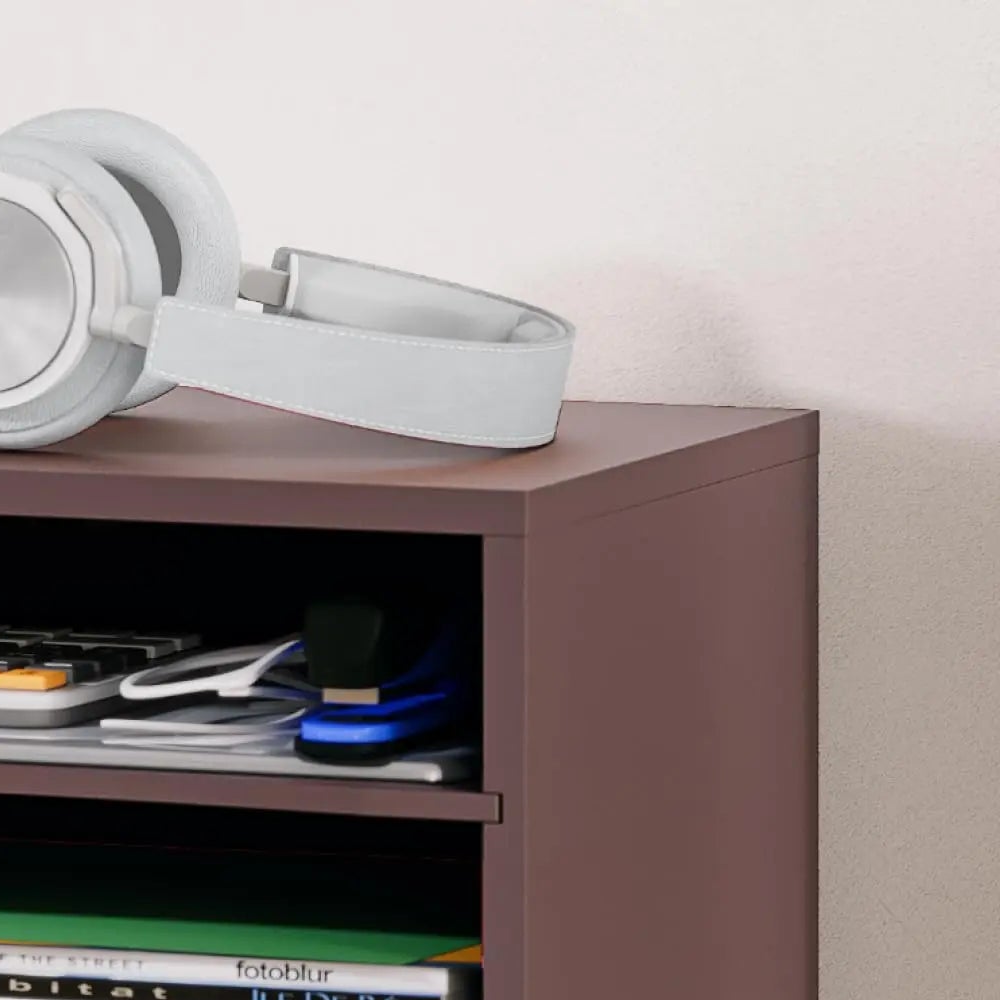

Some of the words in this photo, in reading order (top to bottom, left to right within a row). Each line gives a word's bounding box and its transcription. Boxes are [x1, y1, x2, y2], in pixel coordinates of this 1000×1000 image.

[20, 953, 56, 966] THE
[67, 956, 143, 971] STREET
[235, 959, 335, 984] fotoblur
